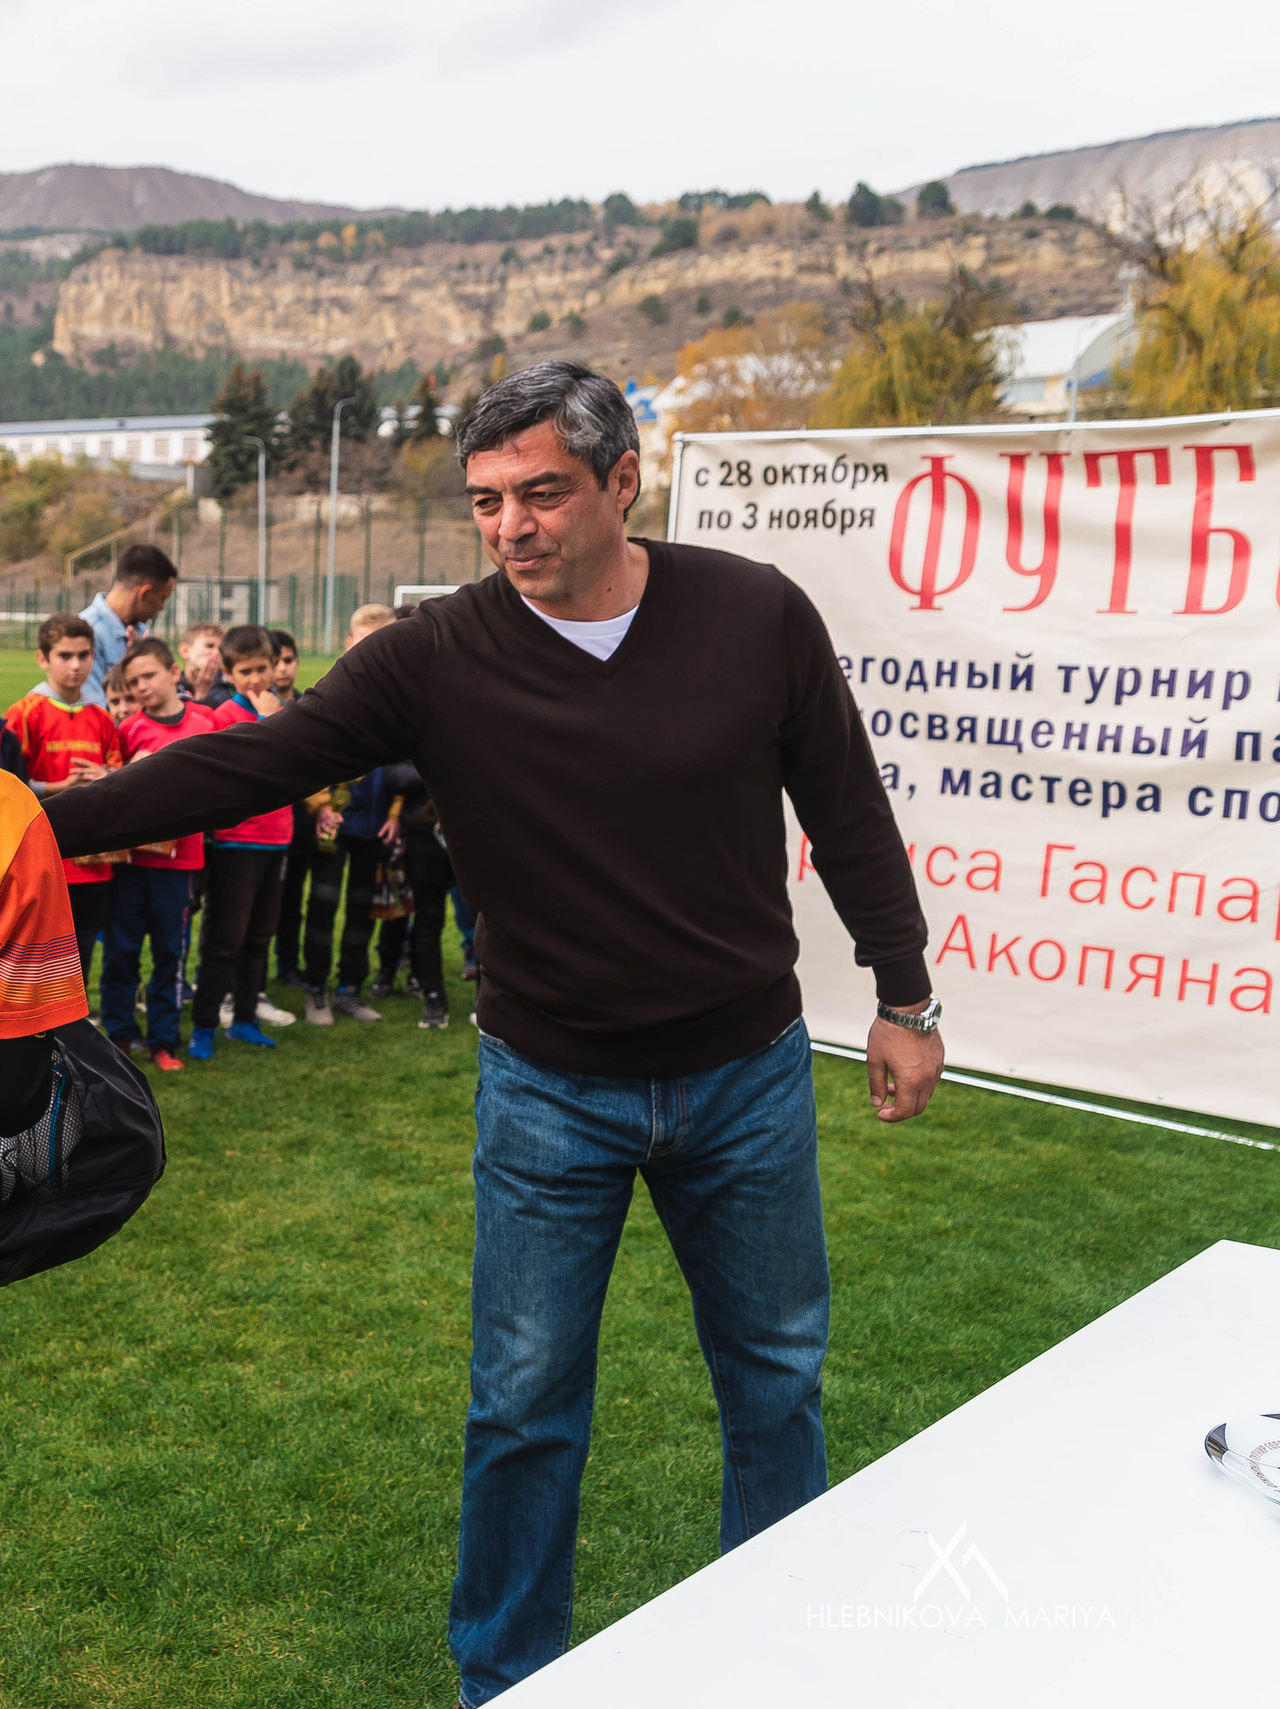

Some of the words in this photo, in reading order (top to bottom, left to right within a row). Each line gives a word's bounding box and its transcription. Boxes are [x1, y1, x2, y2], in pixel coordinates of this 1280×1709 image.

[694, 466, 711, 487] с
[719, 459, 753, 487] 28
[763, 453, 890, 490] октября
[697, 508, 732, 530] по
[741, 502, 759, 531] 3
[768, 498, 877, 536] ноября
[887, 444, 1280, 616] ФУТБ
[837, 651, 1035, 693] егодный
[1057, 664, 1252, 711] турнир
[858, 707, 1208, 759] освященный
[940, 767, 1162, 818] мастера
[1040, 843, 1280, 942] Гаспа
[934, 913, 1275, 1015] Акопяна
